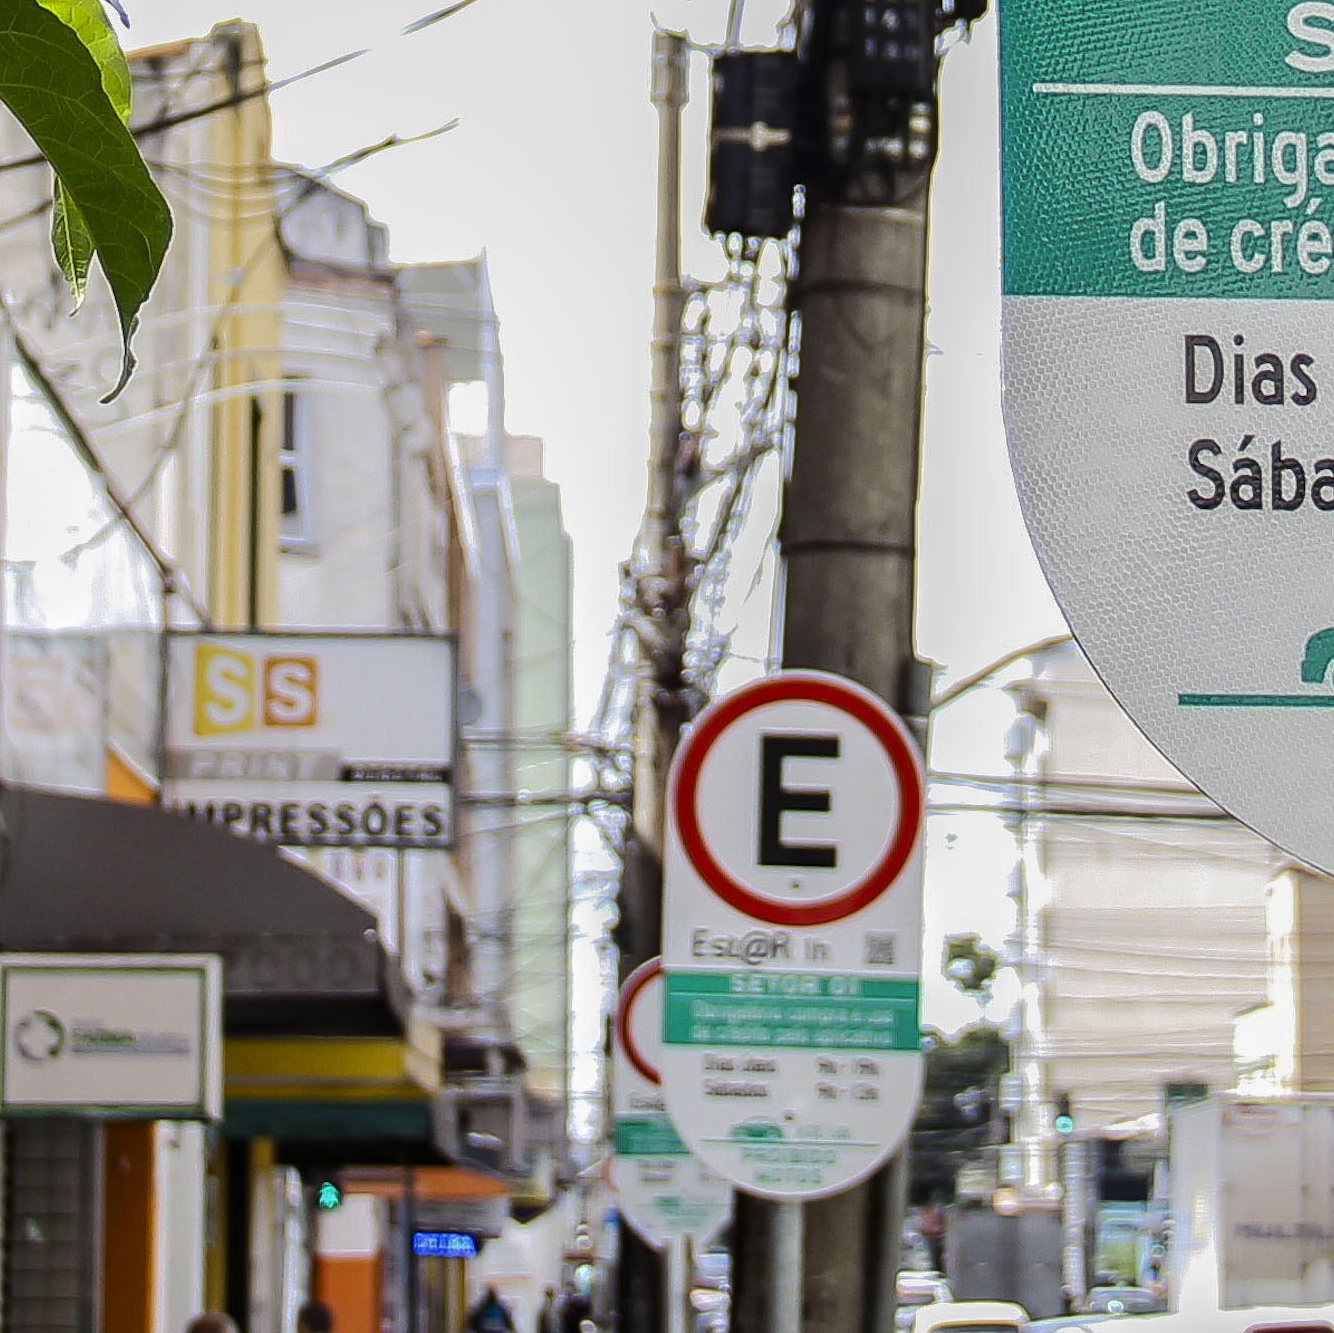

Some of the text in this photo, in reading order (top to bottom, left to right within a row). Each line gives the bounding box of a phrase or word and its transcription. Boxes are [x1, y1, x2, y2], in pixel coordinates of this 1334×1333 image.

[1131, 203, 1207, 271] de
[1185, 336, 1316, 406] Dias
[757, 733, 841, 868] E
